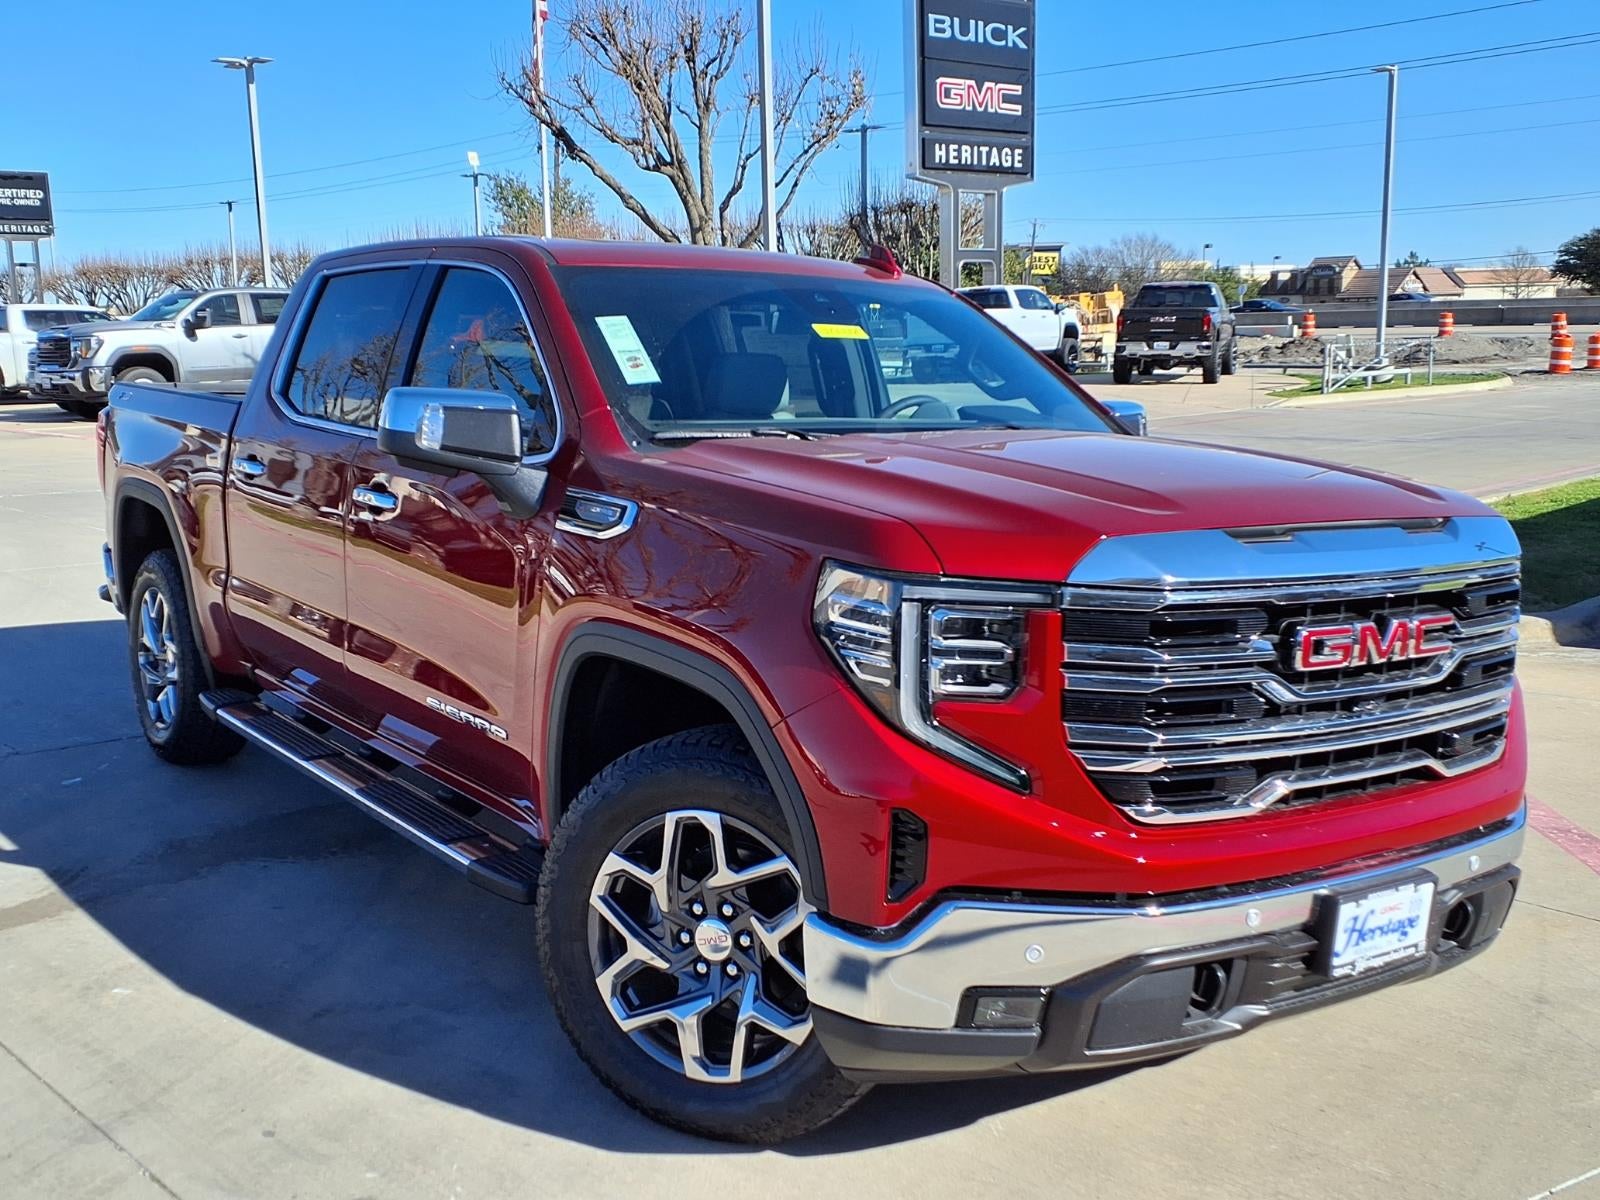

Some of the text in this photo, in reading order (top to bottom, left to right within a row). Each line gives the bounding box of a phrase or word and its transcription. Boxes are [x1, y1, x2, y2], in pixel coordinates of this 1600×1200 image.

[928, 13, 1028, 49] BUICK
[936, 76, 1022, 115] GMC
[934, 143, 1023, 168] HERITAGE
[0, 188, 44, 198] ERTIFIED
[1295, 613, 1457, 671] GMC
[426, 696, 509, 741] SIERRA
[698, 935, 728, 946] GMC
